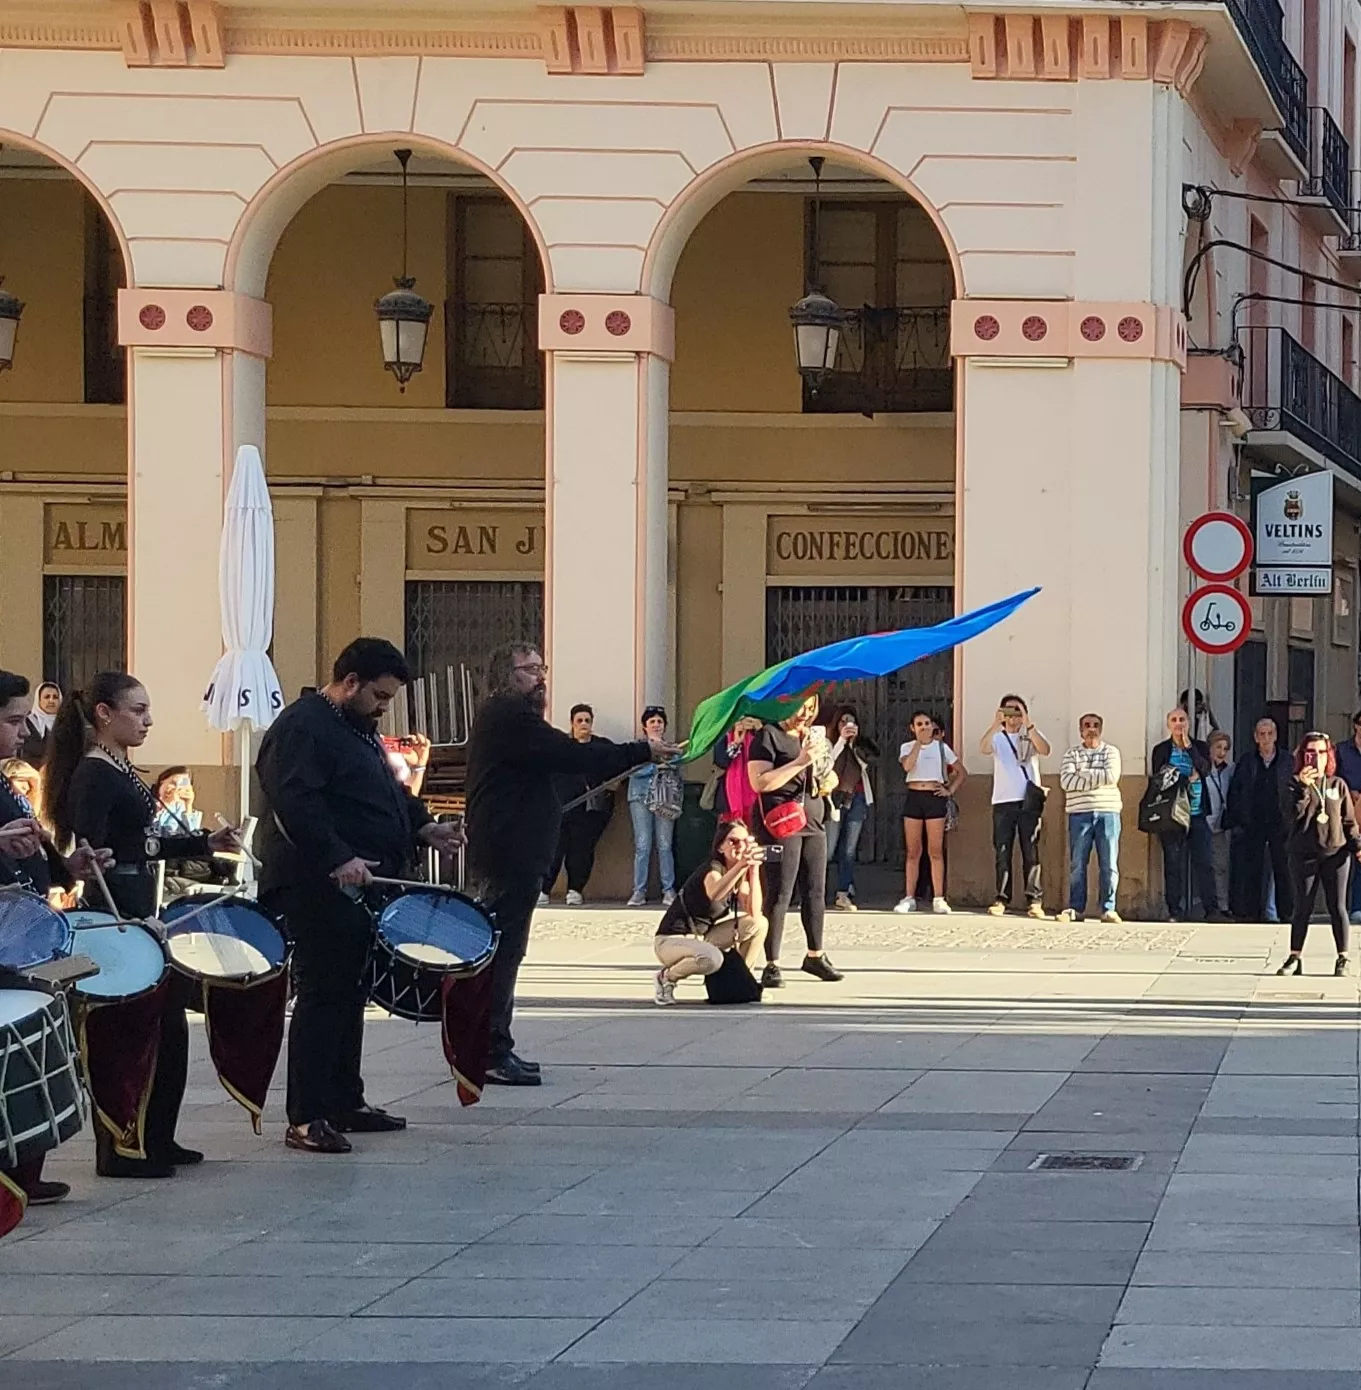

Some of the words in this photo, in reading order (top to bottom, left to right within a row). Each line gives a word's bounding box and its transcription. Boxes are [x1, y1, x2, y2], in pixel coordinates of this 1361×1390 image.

[1265, 523, 1323, 538] VELTINS
[426, 525, 499, 554] SAN
[515, 526, 546, 554] J
[1261, 573, 1281, 587] Alt
[1285, 573, 1326, 588] Berlin
